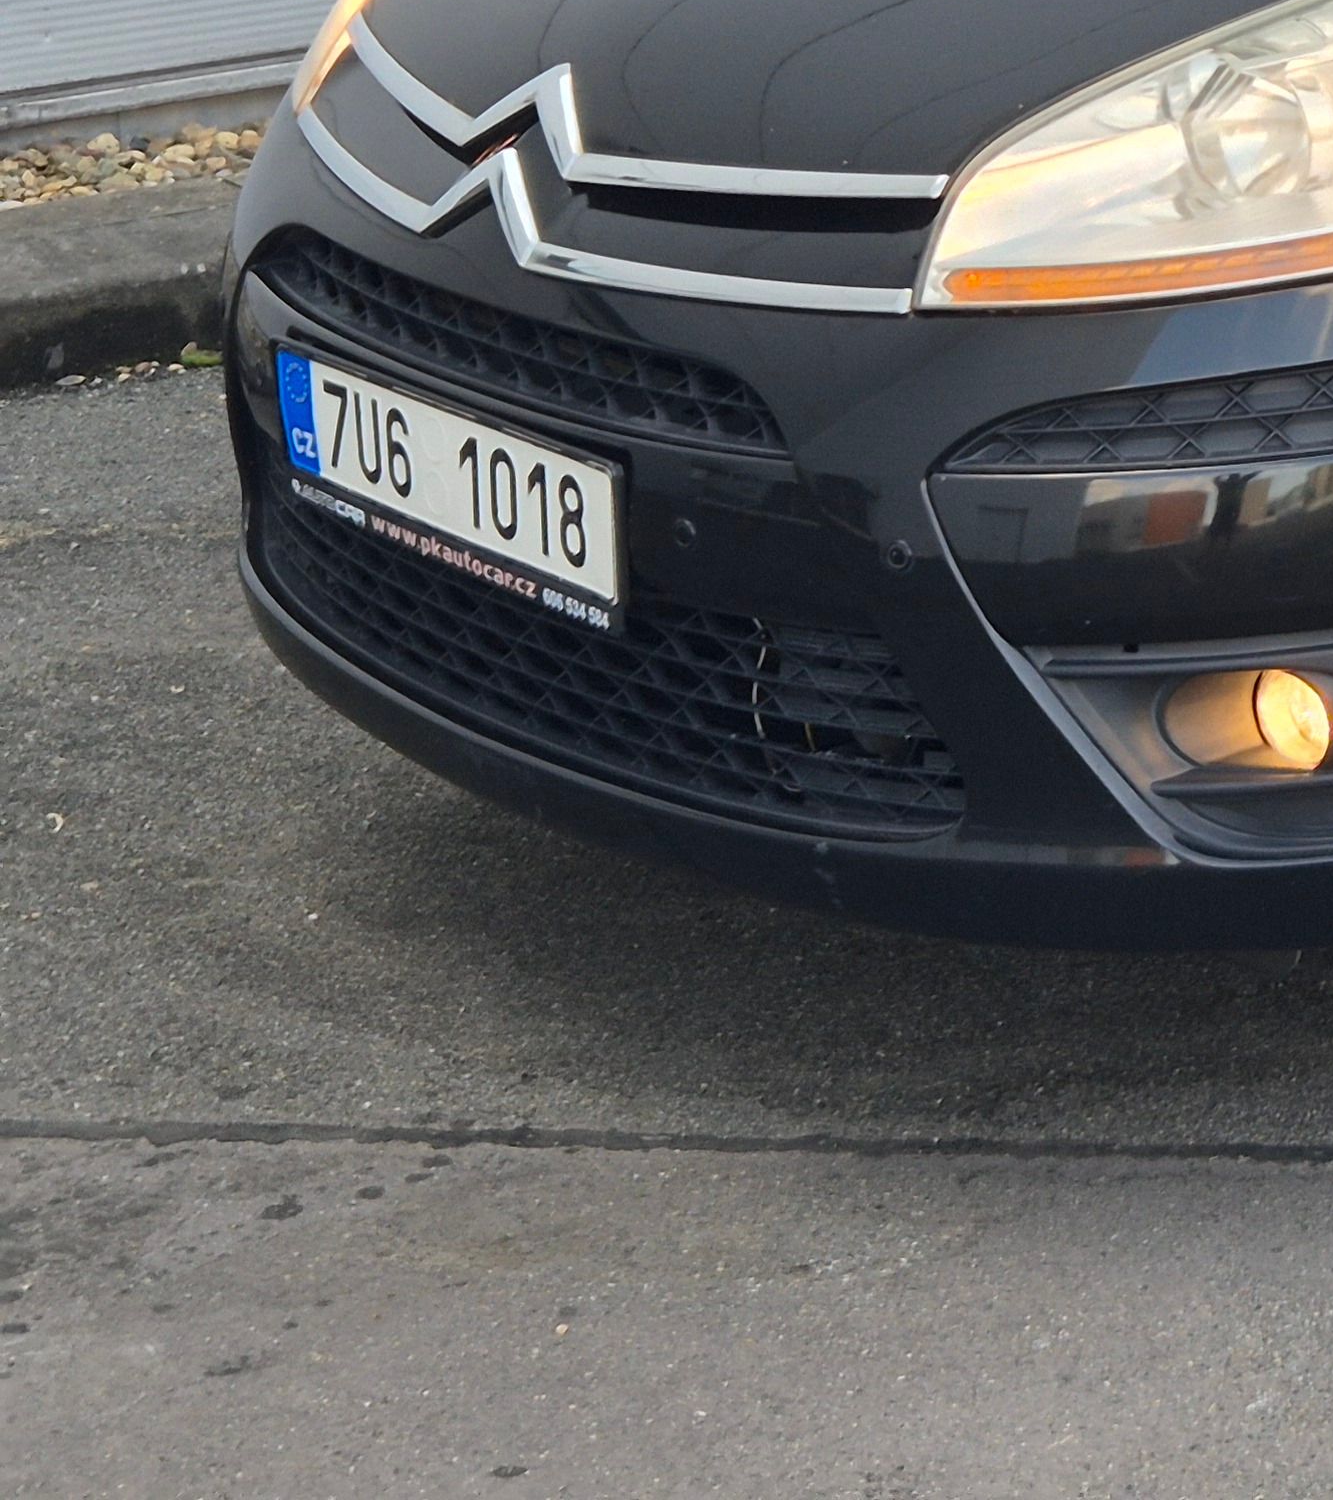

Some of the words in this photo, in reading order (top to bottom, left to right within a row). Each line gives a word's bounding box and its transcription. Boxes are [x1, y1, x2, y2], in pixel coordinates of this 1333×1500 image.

[292, 427, 316, 458] CZ
[322, 379, 412, 499] 7U6
[459, 436, 587, 568] 1018
[370, 515, 538, 599] www.pkautocar.cz
